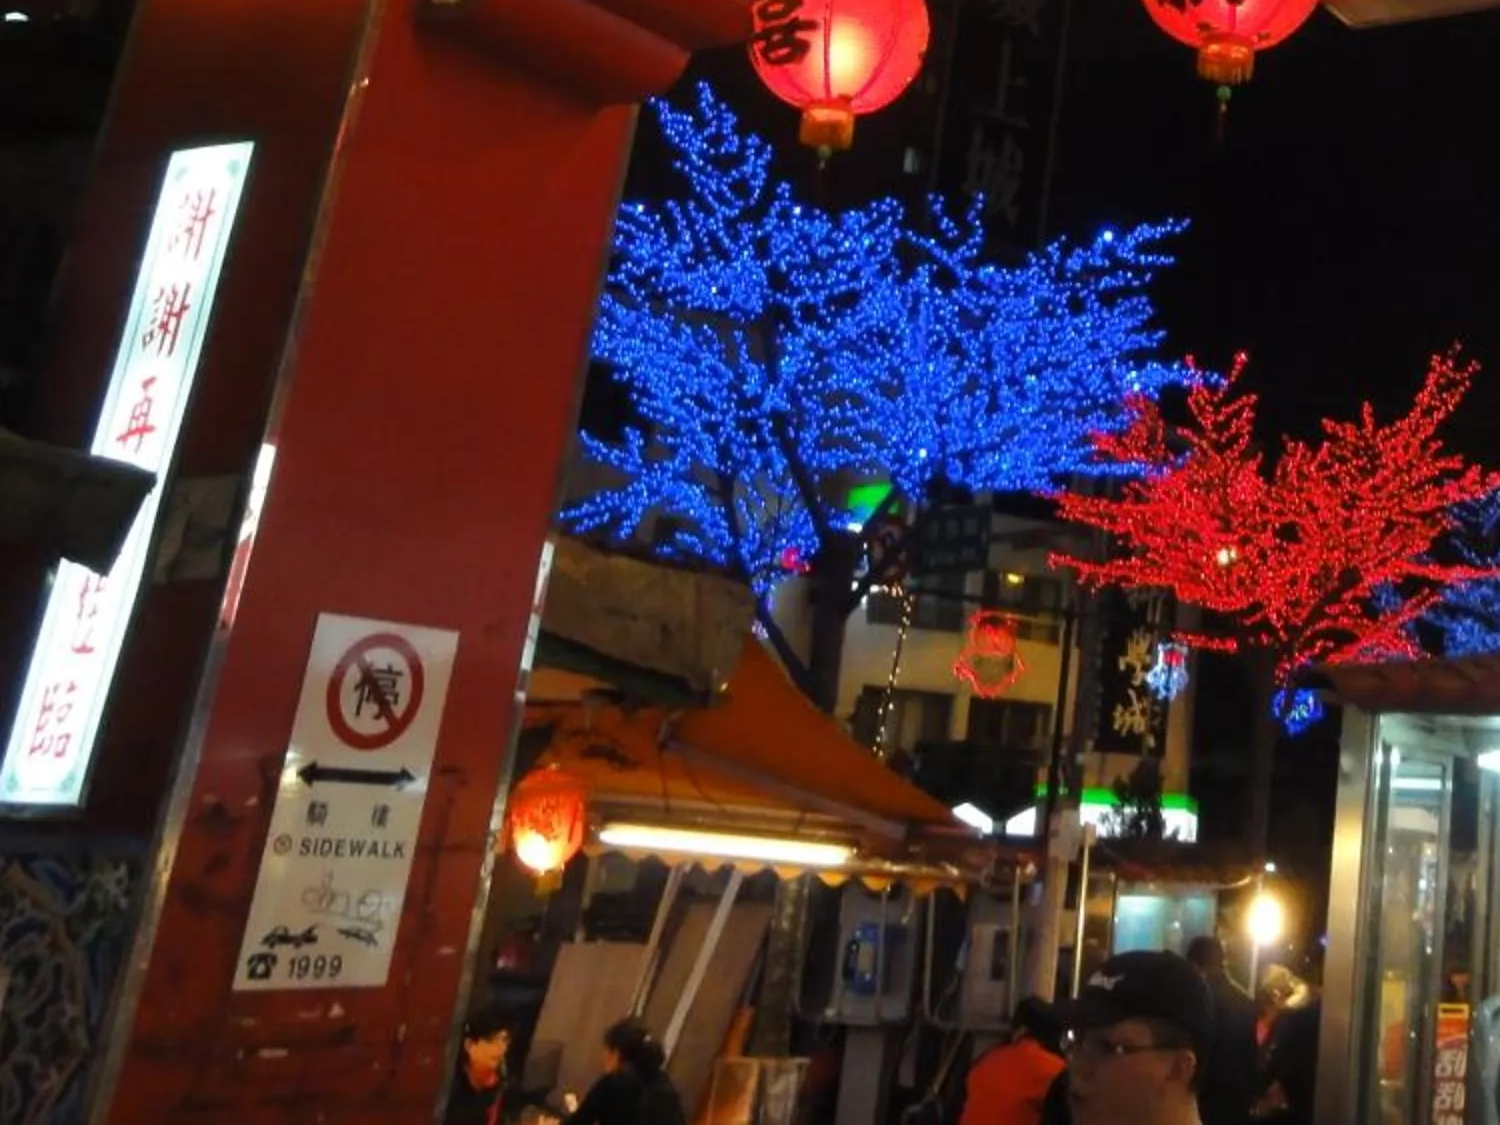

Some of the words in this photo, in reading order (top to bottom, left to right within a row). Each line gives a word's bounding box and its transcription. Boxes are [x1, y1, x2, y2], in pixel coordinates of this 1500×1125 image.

[353, 662, 404, 720] 停
[298, 837, 406, 858] SIDEWALK
[288, 955, 343, 976] 1999
